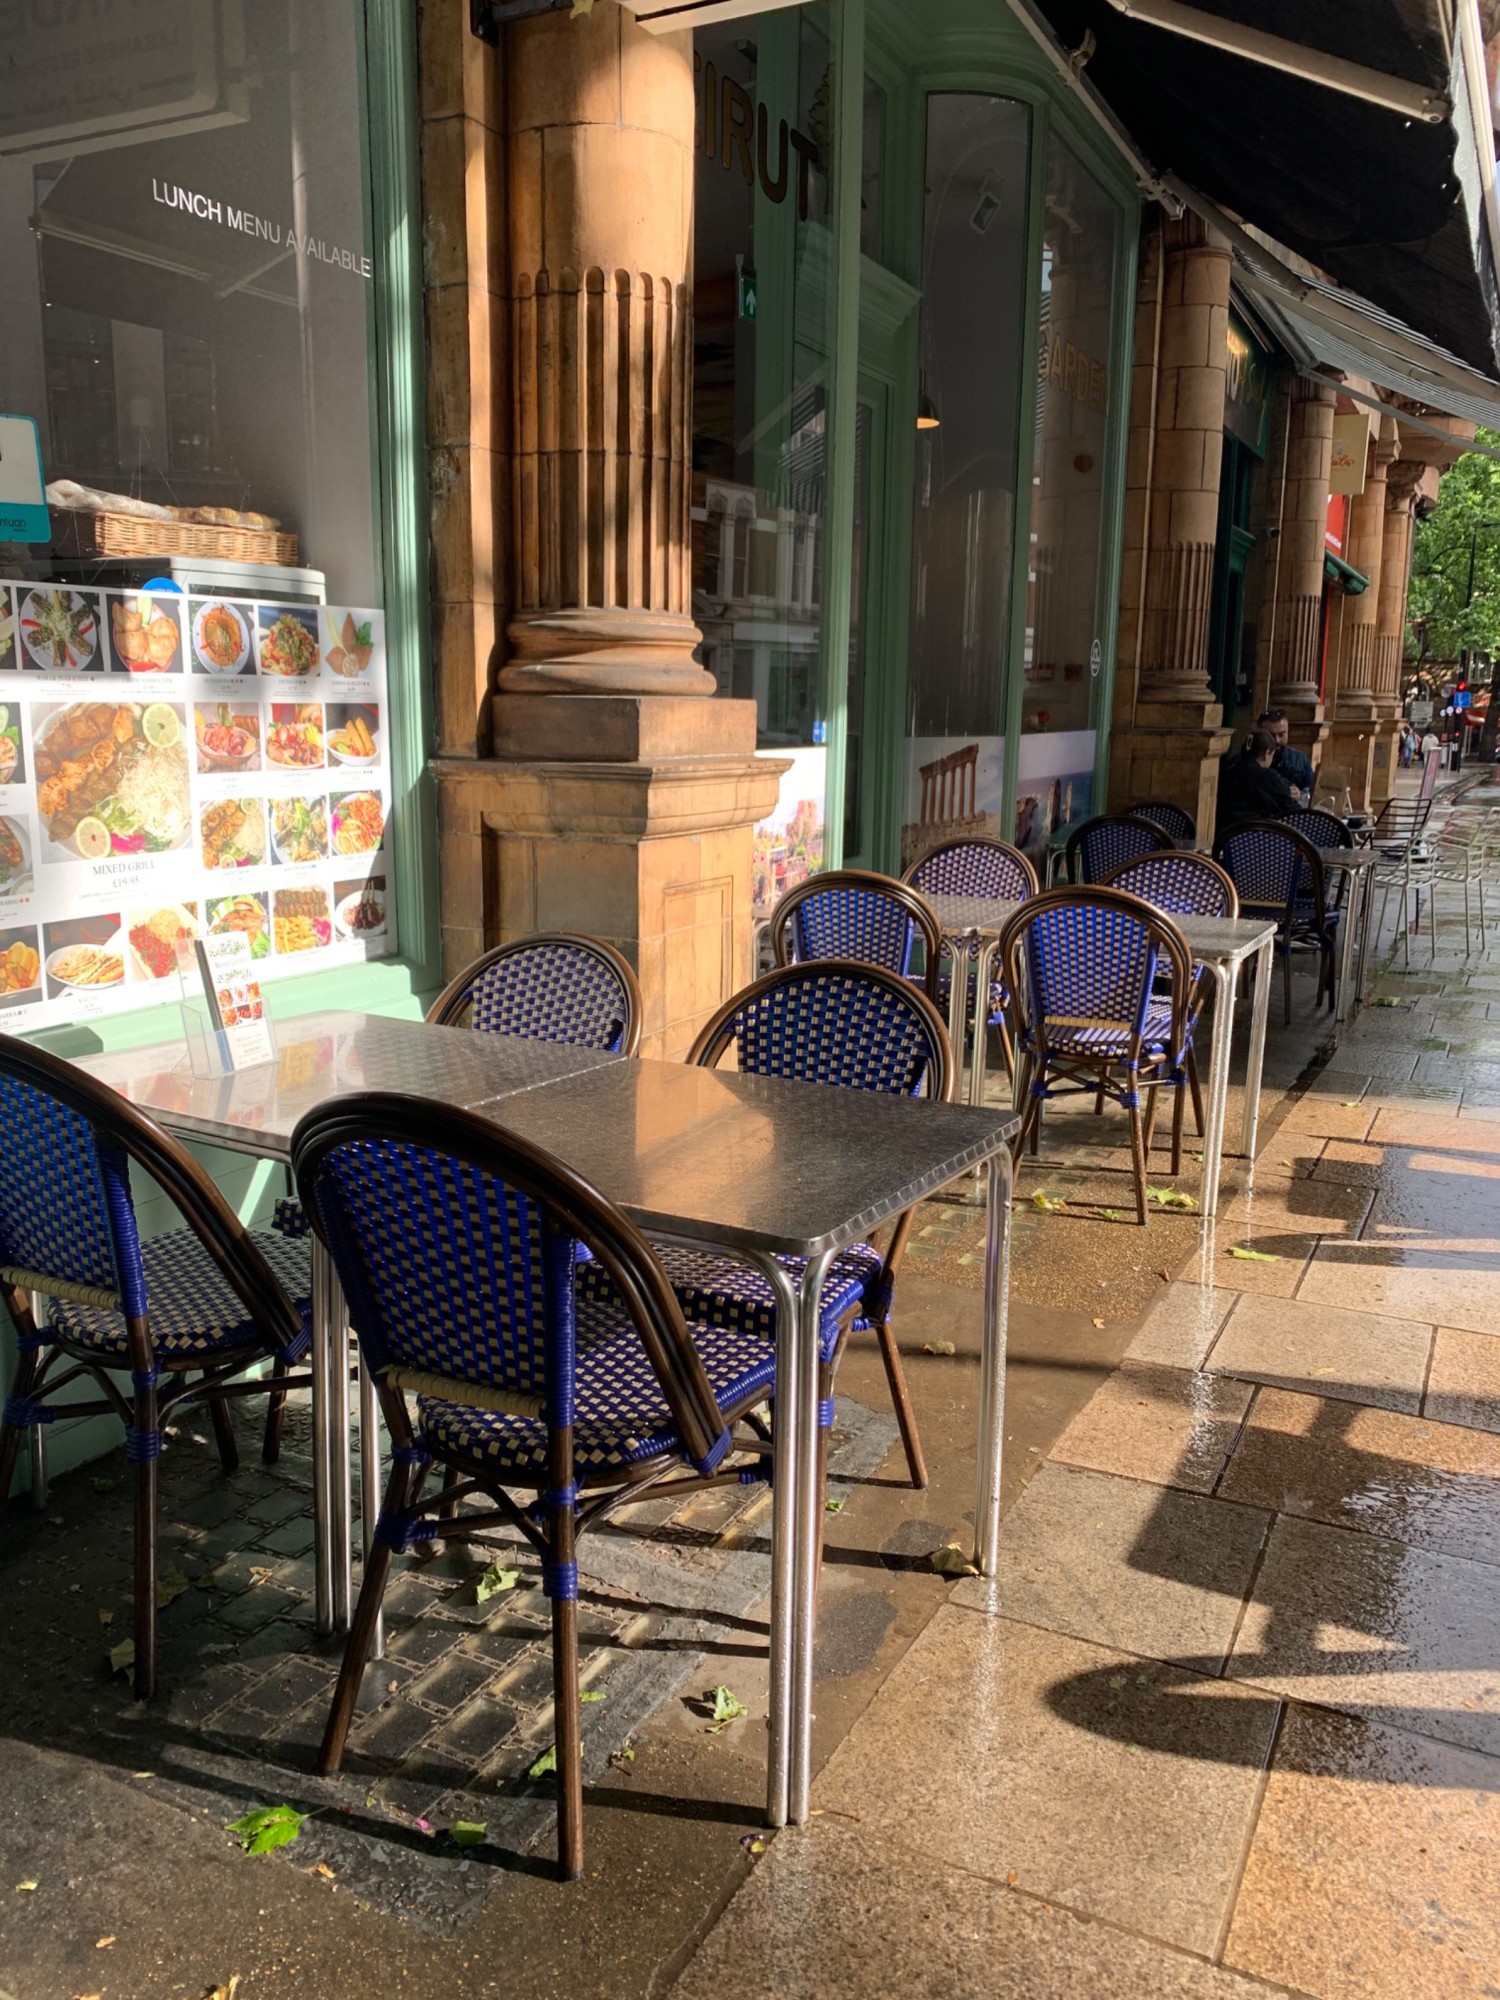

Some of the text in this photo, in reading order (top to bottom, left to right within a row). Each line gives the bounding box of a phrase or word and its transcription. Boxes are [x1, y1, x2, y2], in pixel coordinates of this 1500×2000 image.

[693, 50, 818, 222] IRUT
[152, 178, 371, 278] LUNCH MENU AVAILABLE
[92, 860, 156, 876] MIXED GRILL
